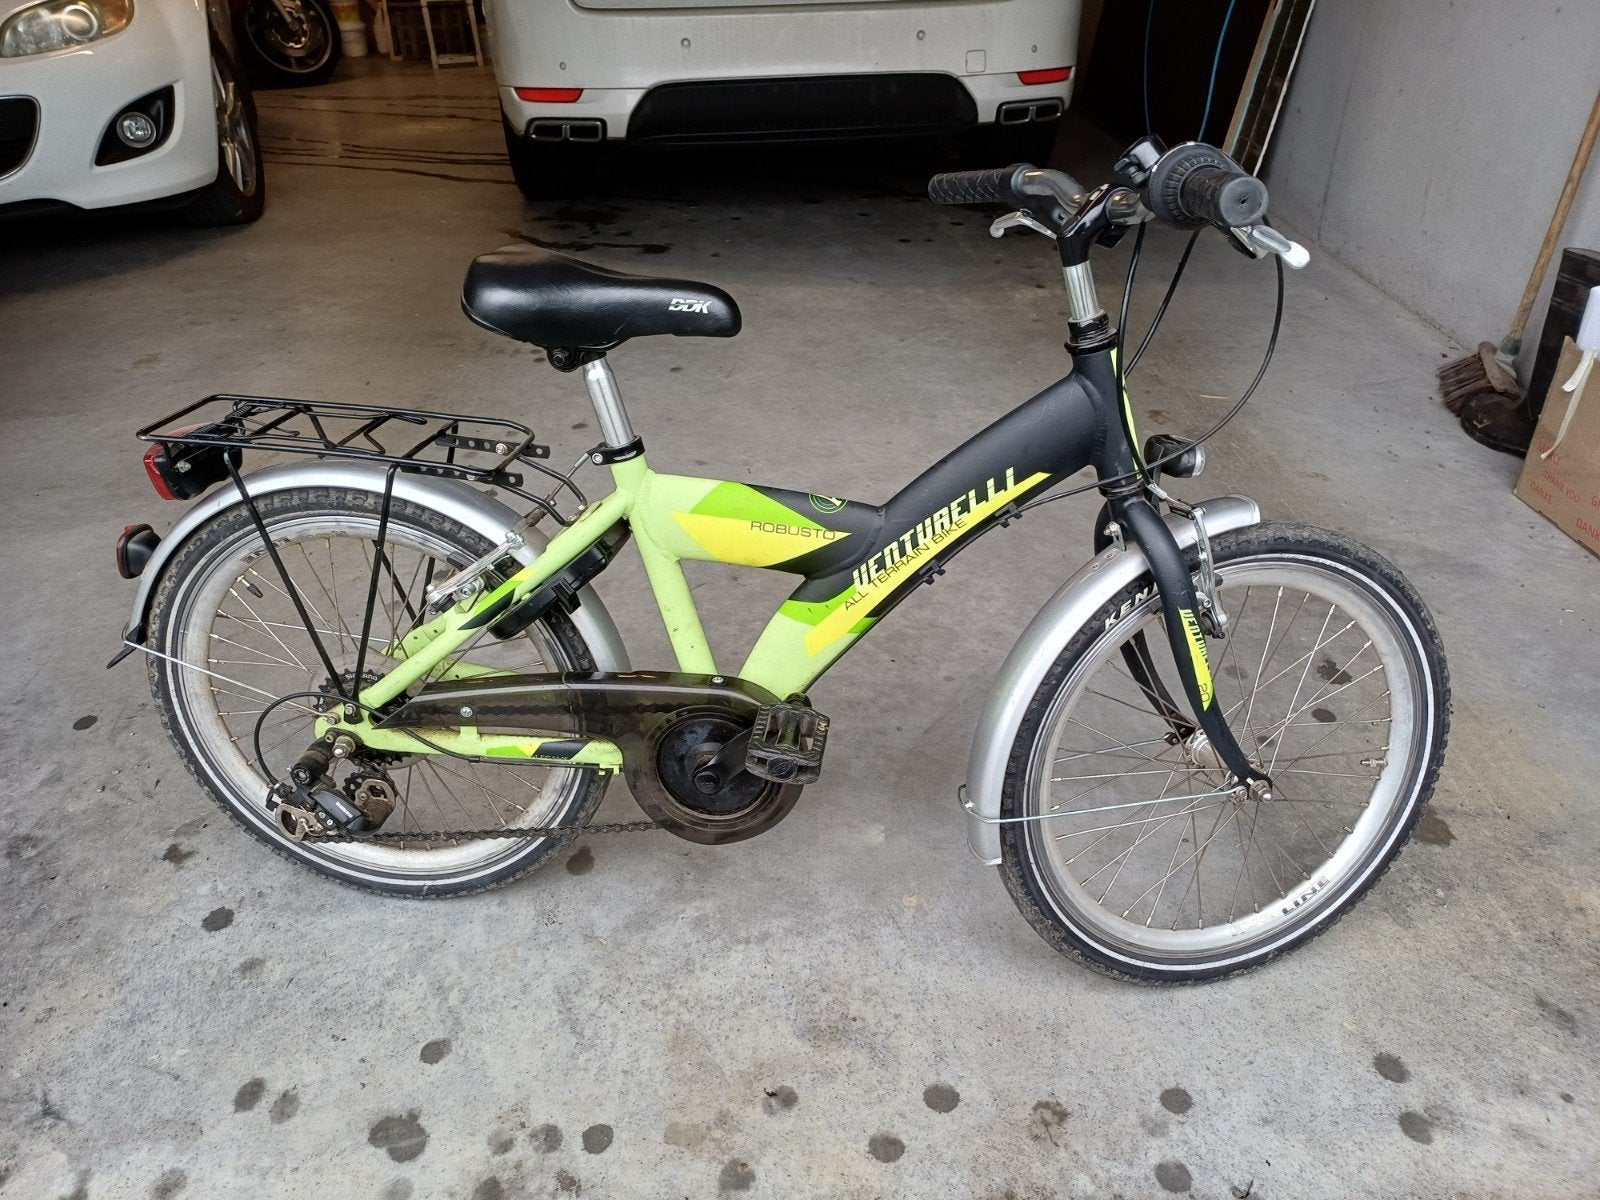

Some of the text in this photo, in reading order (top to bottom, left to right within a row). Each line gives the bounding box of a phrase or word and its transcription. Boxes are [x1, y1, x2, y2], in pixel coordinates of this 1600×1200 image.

[668, 298, 712, 314] DDK
[1530, 480, 1553, 504] DANKE
[1544, 469, 1580, 503] THANK YOU
[750, 521, 836, 540] ROBUSTO
[852, 467, 1015, 592] VENTURELLI
[844, 519, 967, 611] ALL TERRAIN BIKE
[1199, 683, 1210, 702] 20
[1282, 875, 1330, 916] LINE
